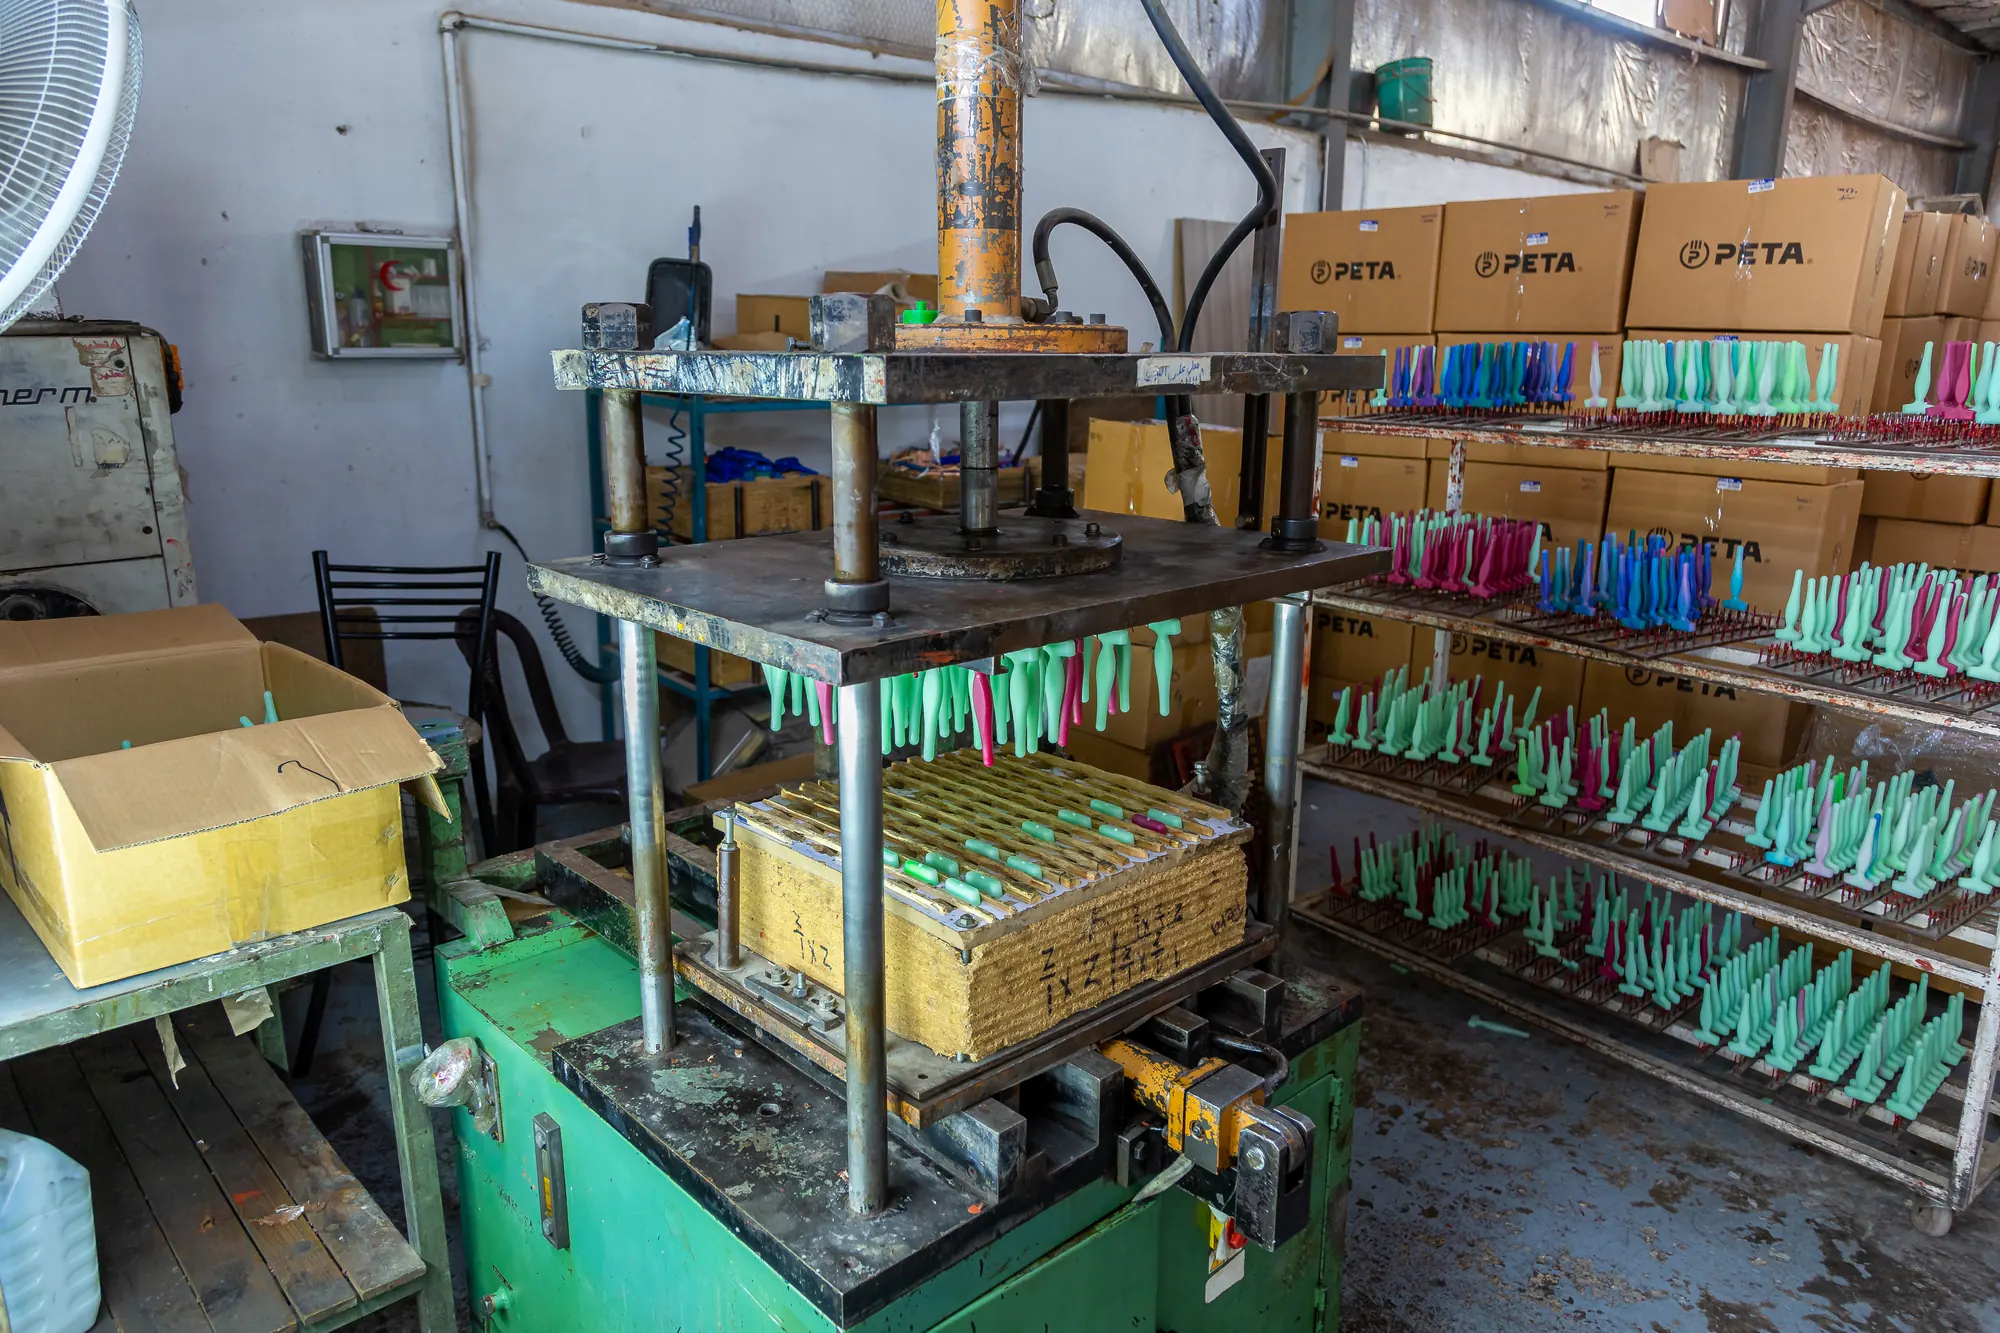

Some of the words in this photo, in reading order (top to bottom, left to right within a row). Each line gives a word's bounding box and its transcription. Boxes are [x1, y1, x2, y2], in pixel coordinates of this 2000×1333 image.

[1503, 252, 1576, 274] PETA
[1714, 242, 1804, 265] PETA
[1335, 261, 1396, 281] PETA
[1326, 502, 1382, 524] PETA
[1318, 613, 1374, 638] PETA
[1471, 637, 1537, 667] PETA
